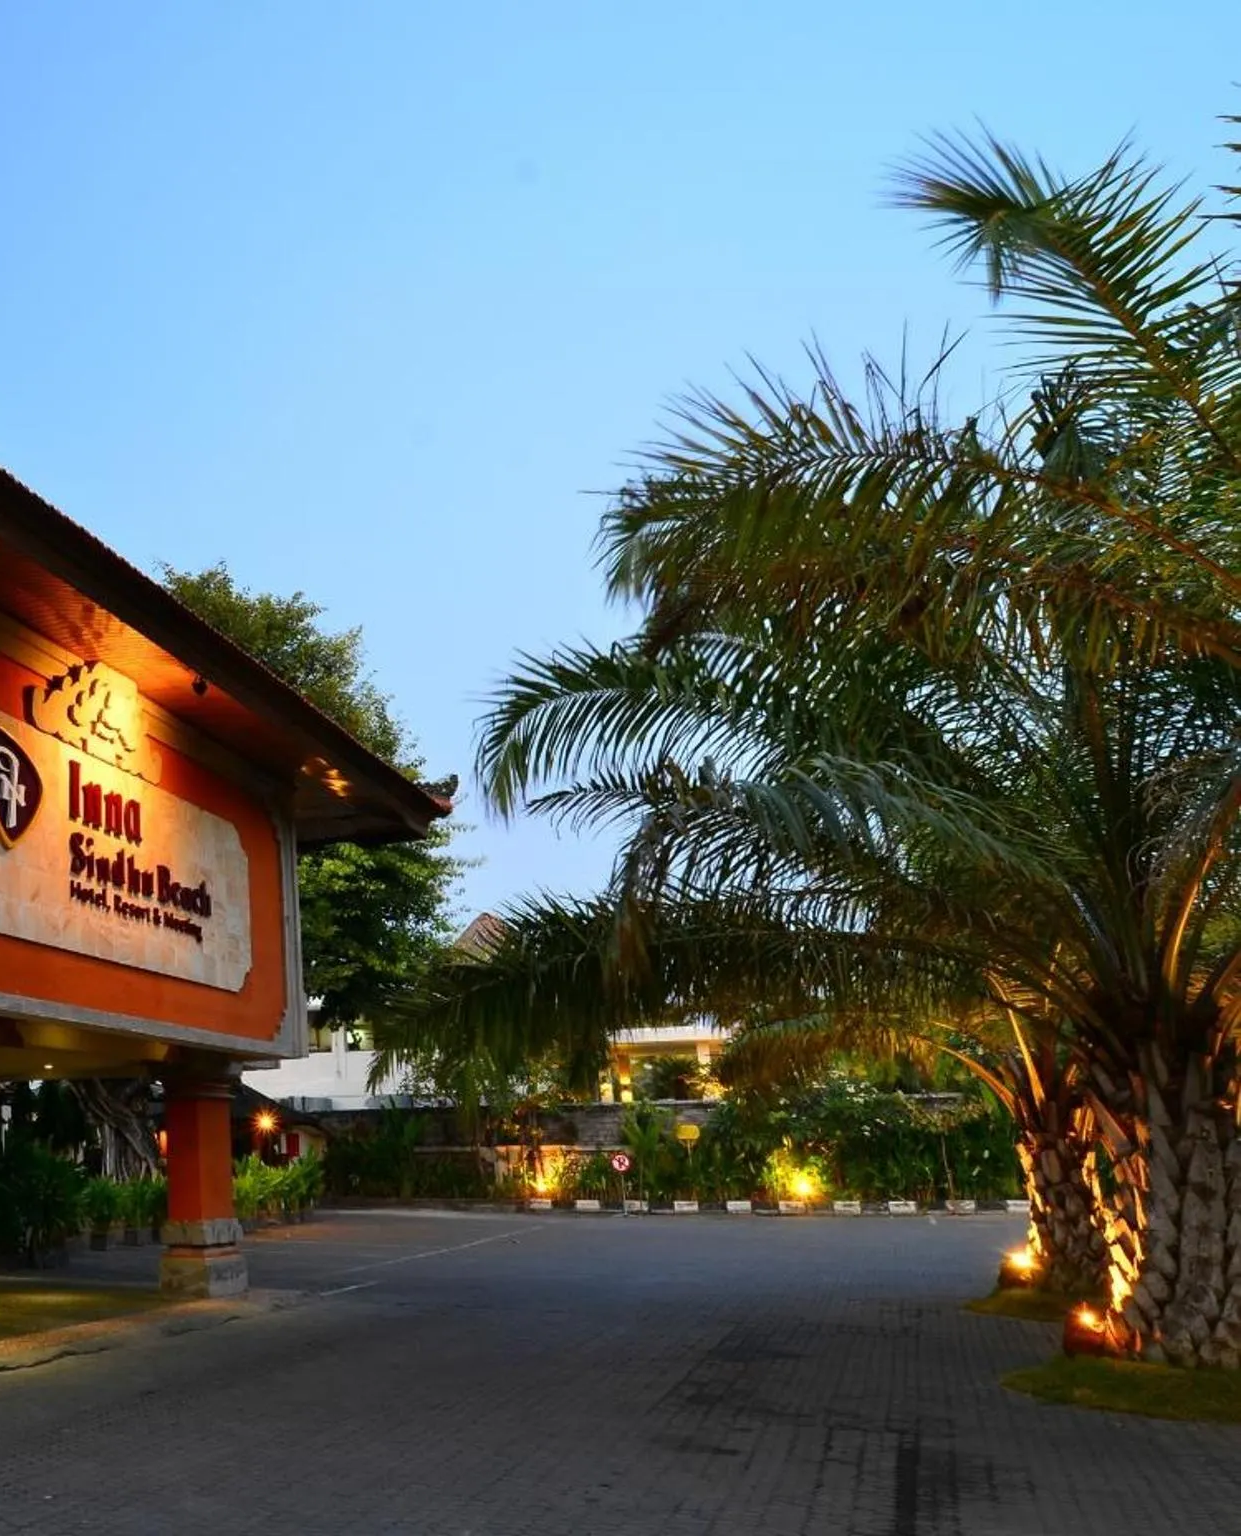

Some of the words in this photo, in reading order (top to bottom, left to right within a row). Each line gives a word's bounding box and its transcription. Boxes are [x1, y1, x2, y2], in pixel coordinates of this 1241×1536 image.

[69, 760, 142, 846] Inna
[70, 832, 154, 896] Sindhu
[156, 865, 212, 918] Beach
[113, 894, 151, 923] Resort
